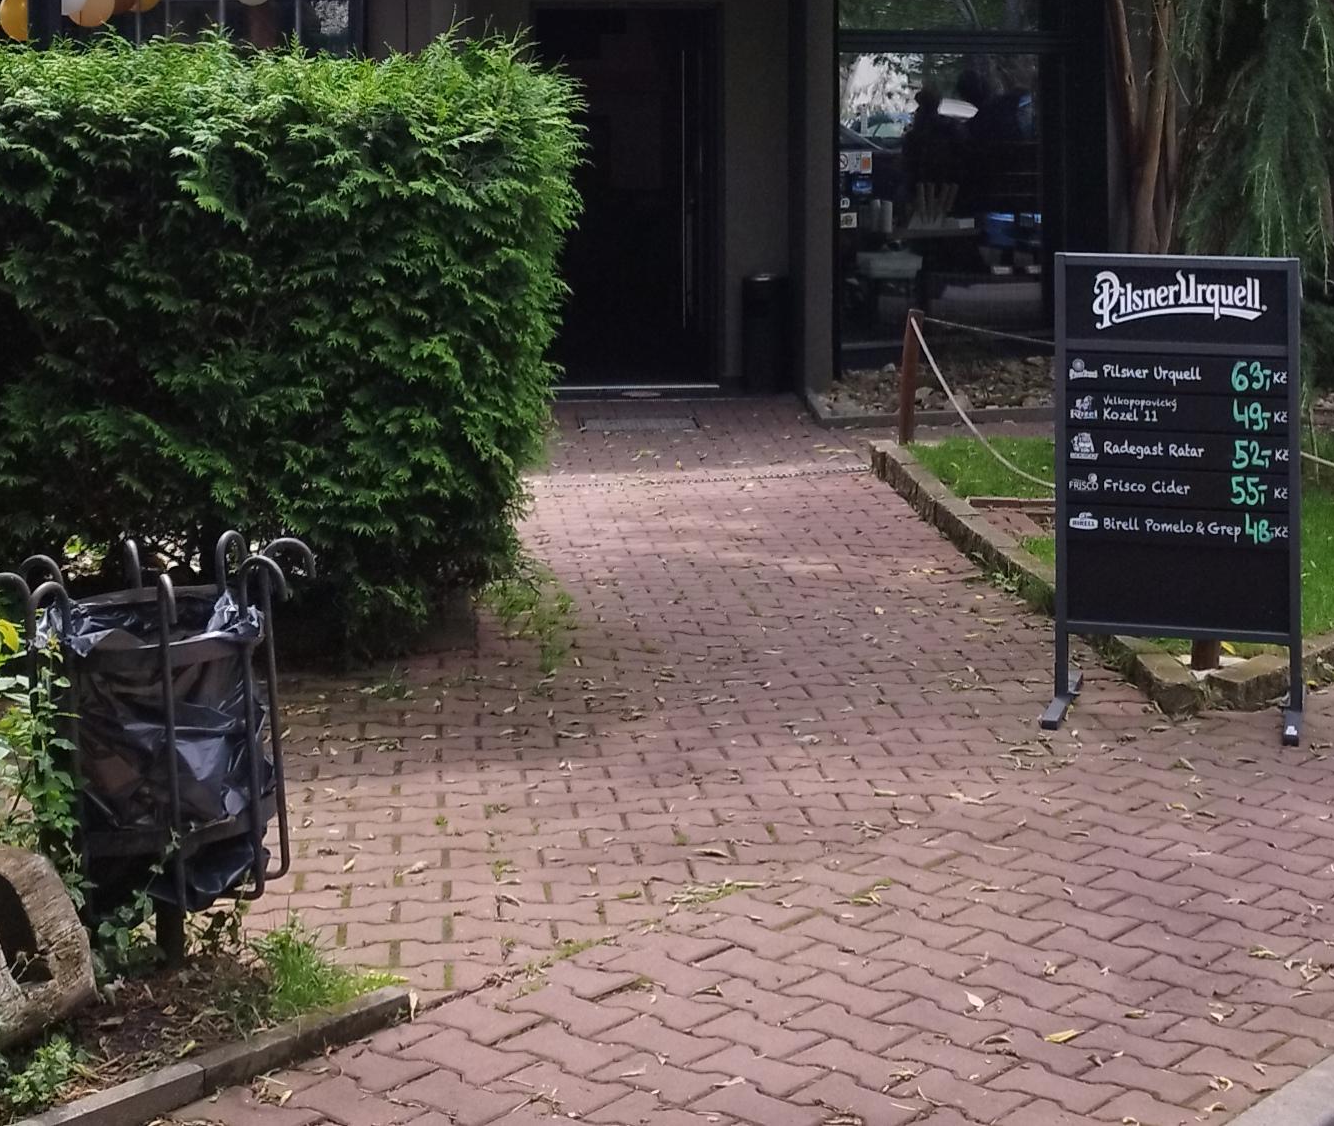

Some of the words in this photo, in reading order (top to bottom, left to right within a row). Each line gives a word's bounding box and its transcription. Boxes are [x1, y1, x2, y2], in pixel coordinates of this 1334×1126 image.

[1092, 270, 1180, 330] Pilsner
[1175, 269, 1261, 321] Urquell
[1102, 364, 1149, 378] Pilsner
[1153, 365, 1202, 386] Urquell
[1273, 371, 1288, 384] Kč
[1103, 395, 1177, 412] Velkopopovický
[1103, 407, 1139, 422] Kozel
[1144, 409, 1158, 422] 11
[1273, 410, 1288, 423] Kč
[1103, 439, 1164, 460] Radegast
[1168, 442, 1205, 458] Ratar
[1274, 448, 1289, 462] Kč
[1068, 479, 1099, 491] FRISCO
[1103, 478, 1146, 492] Frisco
[1151, 479, 1191, 494] Cider
[1274, 487, 1288, 500] Kč
[1103, 517, 1140, 531] Birell
[1145, 518, 1194, 533] Pomelo
[1195, 521, 1205, 534] &
[1207, 522, 1242, 543] Grep
[1274, 526, 1288, 538] Kč
